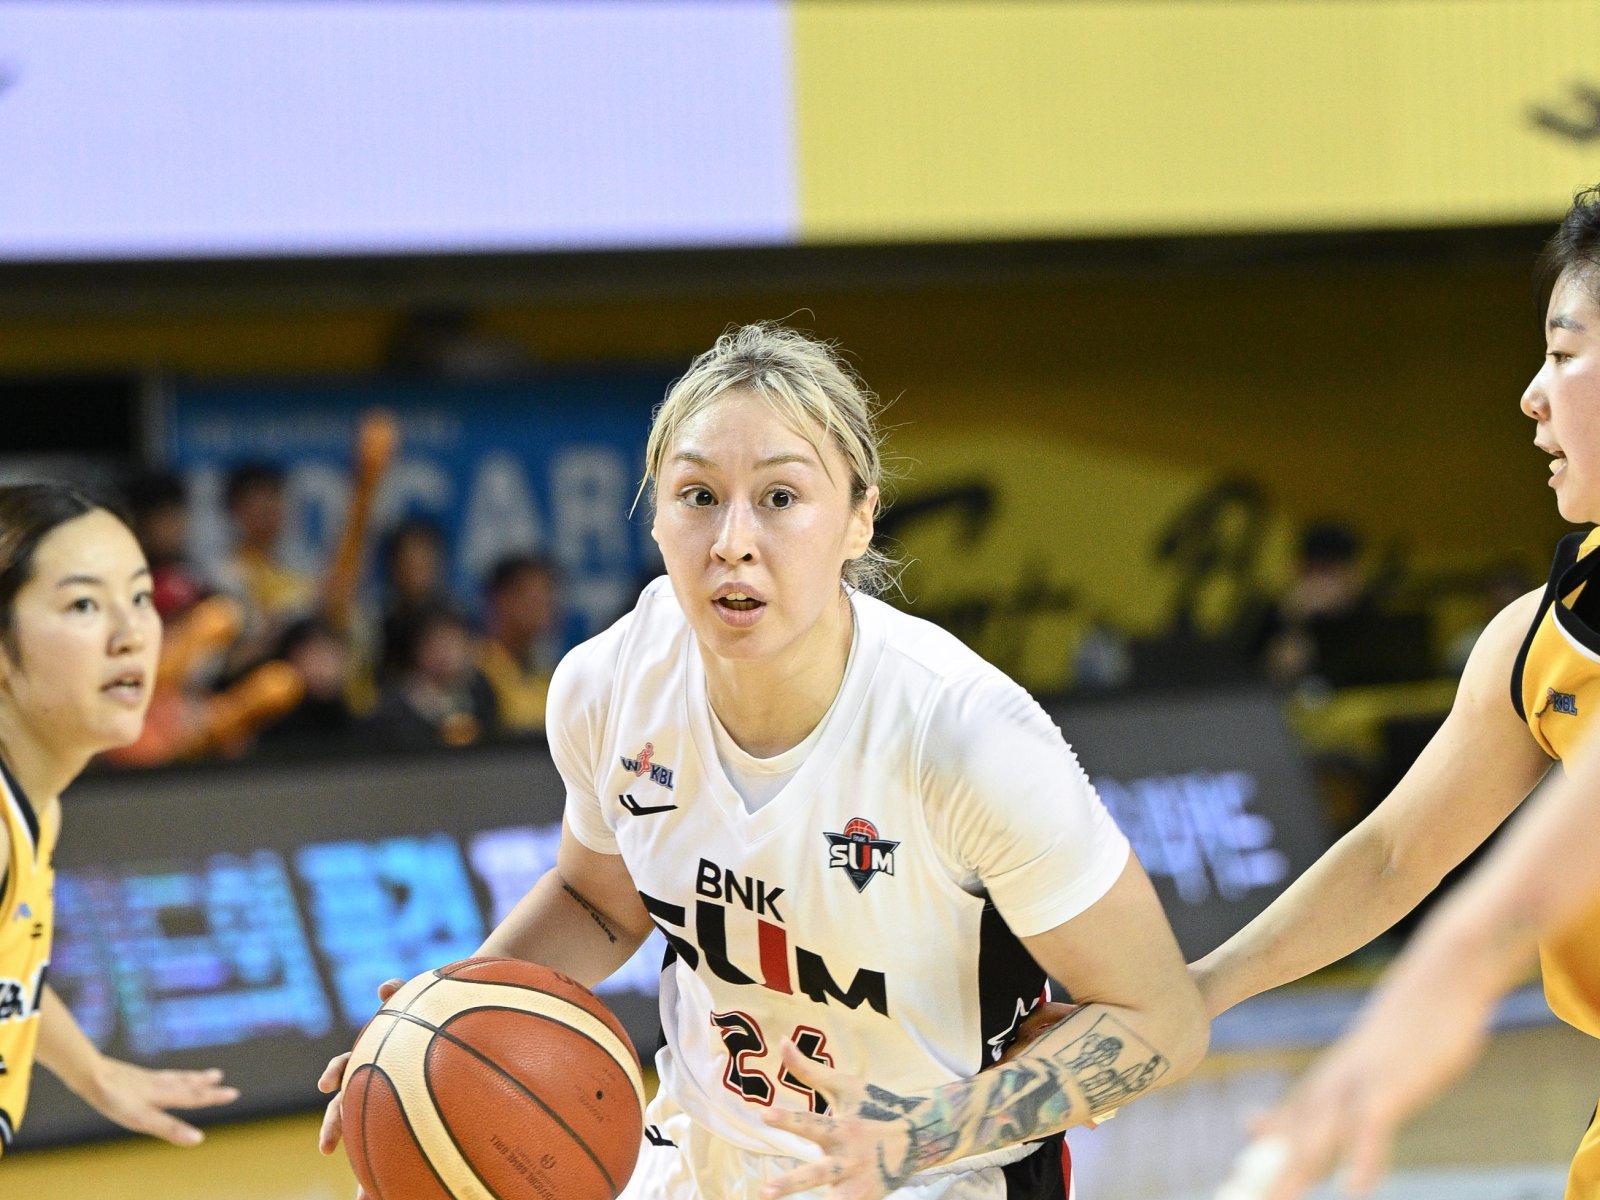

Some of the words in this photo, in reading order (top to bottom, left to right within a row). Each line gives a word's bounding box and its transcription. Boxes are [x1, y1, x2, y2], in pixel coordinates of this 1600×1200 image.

[696, 858, 785, 923] BNK
[829, 842, 894, 876] SUM
[639, 890, 890, 1018] SUM
